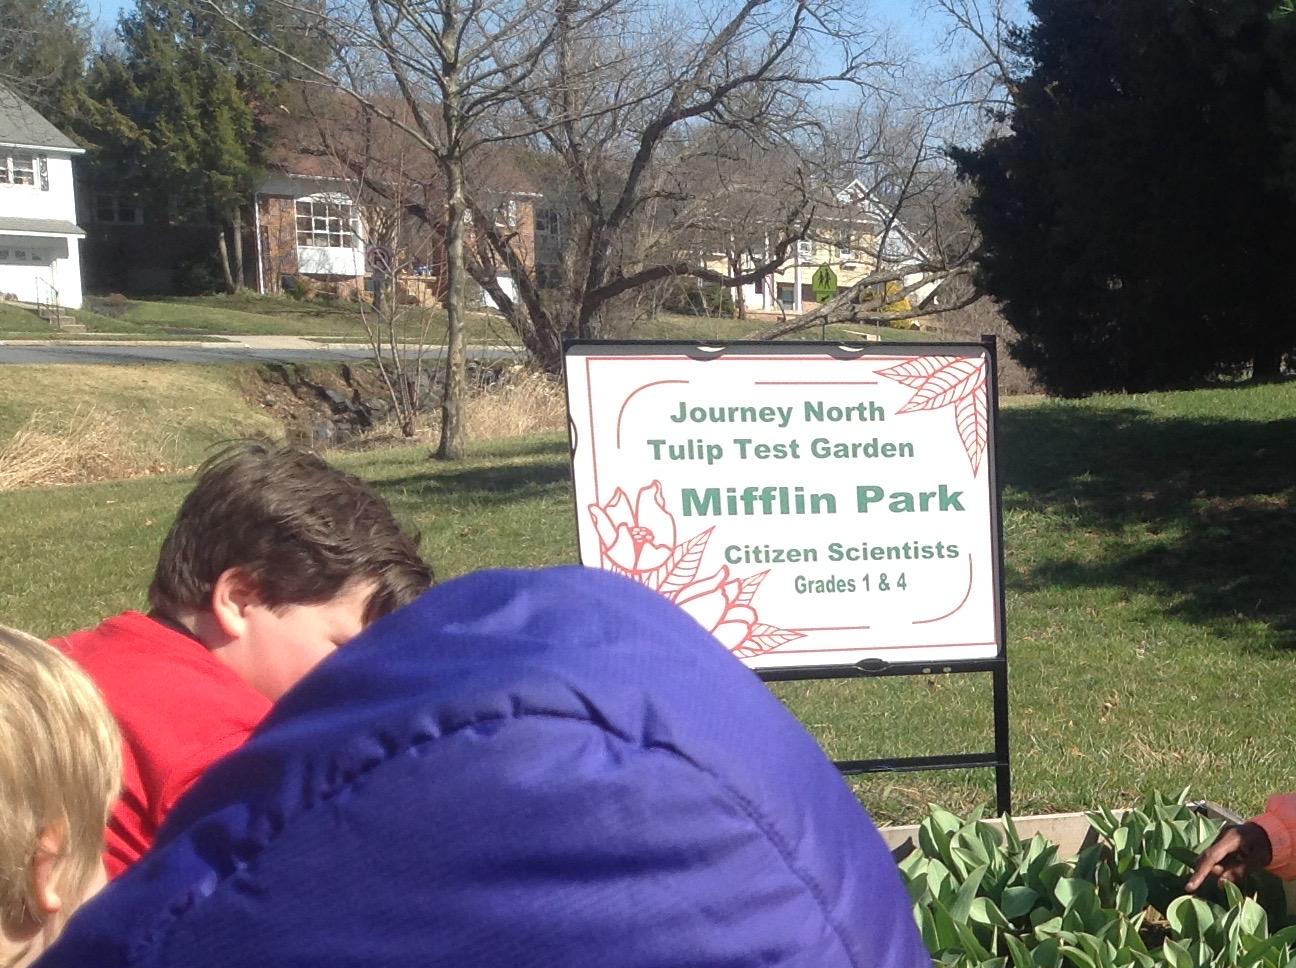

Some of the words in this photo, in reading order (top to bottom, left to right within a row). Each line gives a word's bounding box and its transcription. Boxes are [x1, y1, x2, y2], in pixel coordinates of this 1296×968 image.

[670, 401, 793, 428] Journey
[803, 401, 885, 422] North
[646, 439, 723, 465] Tulip
[733, 438, 800, 459] Test
[810, 438, 915, 459] Garden
[681, 486, 837, 517] Mifflin
[856, 484, 966, 514] Park
[724, 544, 818, 565] Citizen
[828, 541, 960, 562] Scientists
[794, 574, 857, 594] Grades
[862, 574, 871, 592] 1
[878, 572, 891, 592] &
[896, 572, 907, 591] 4
